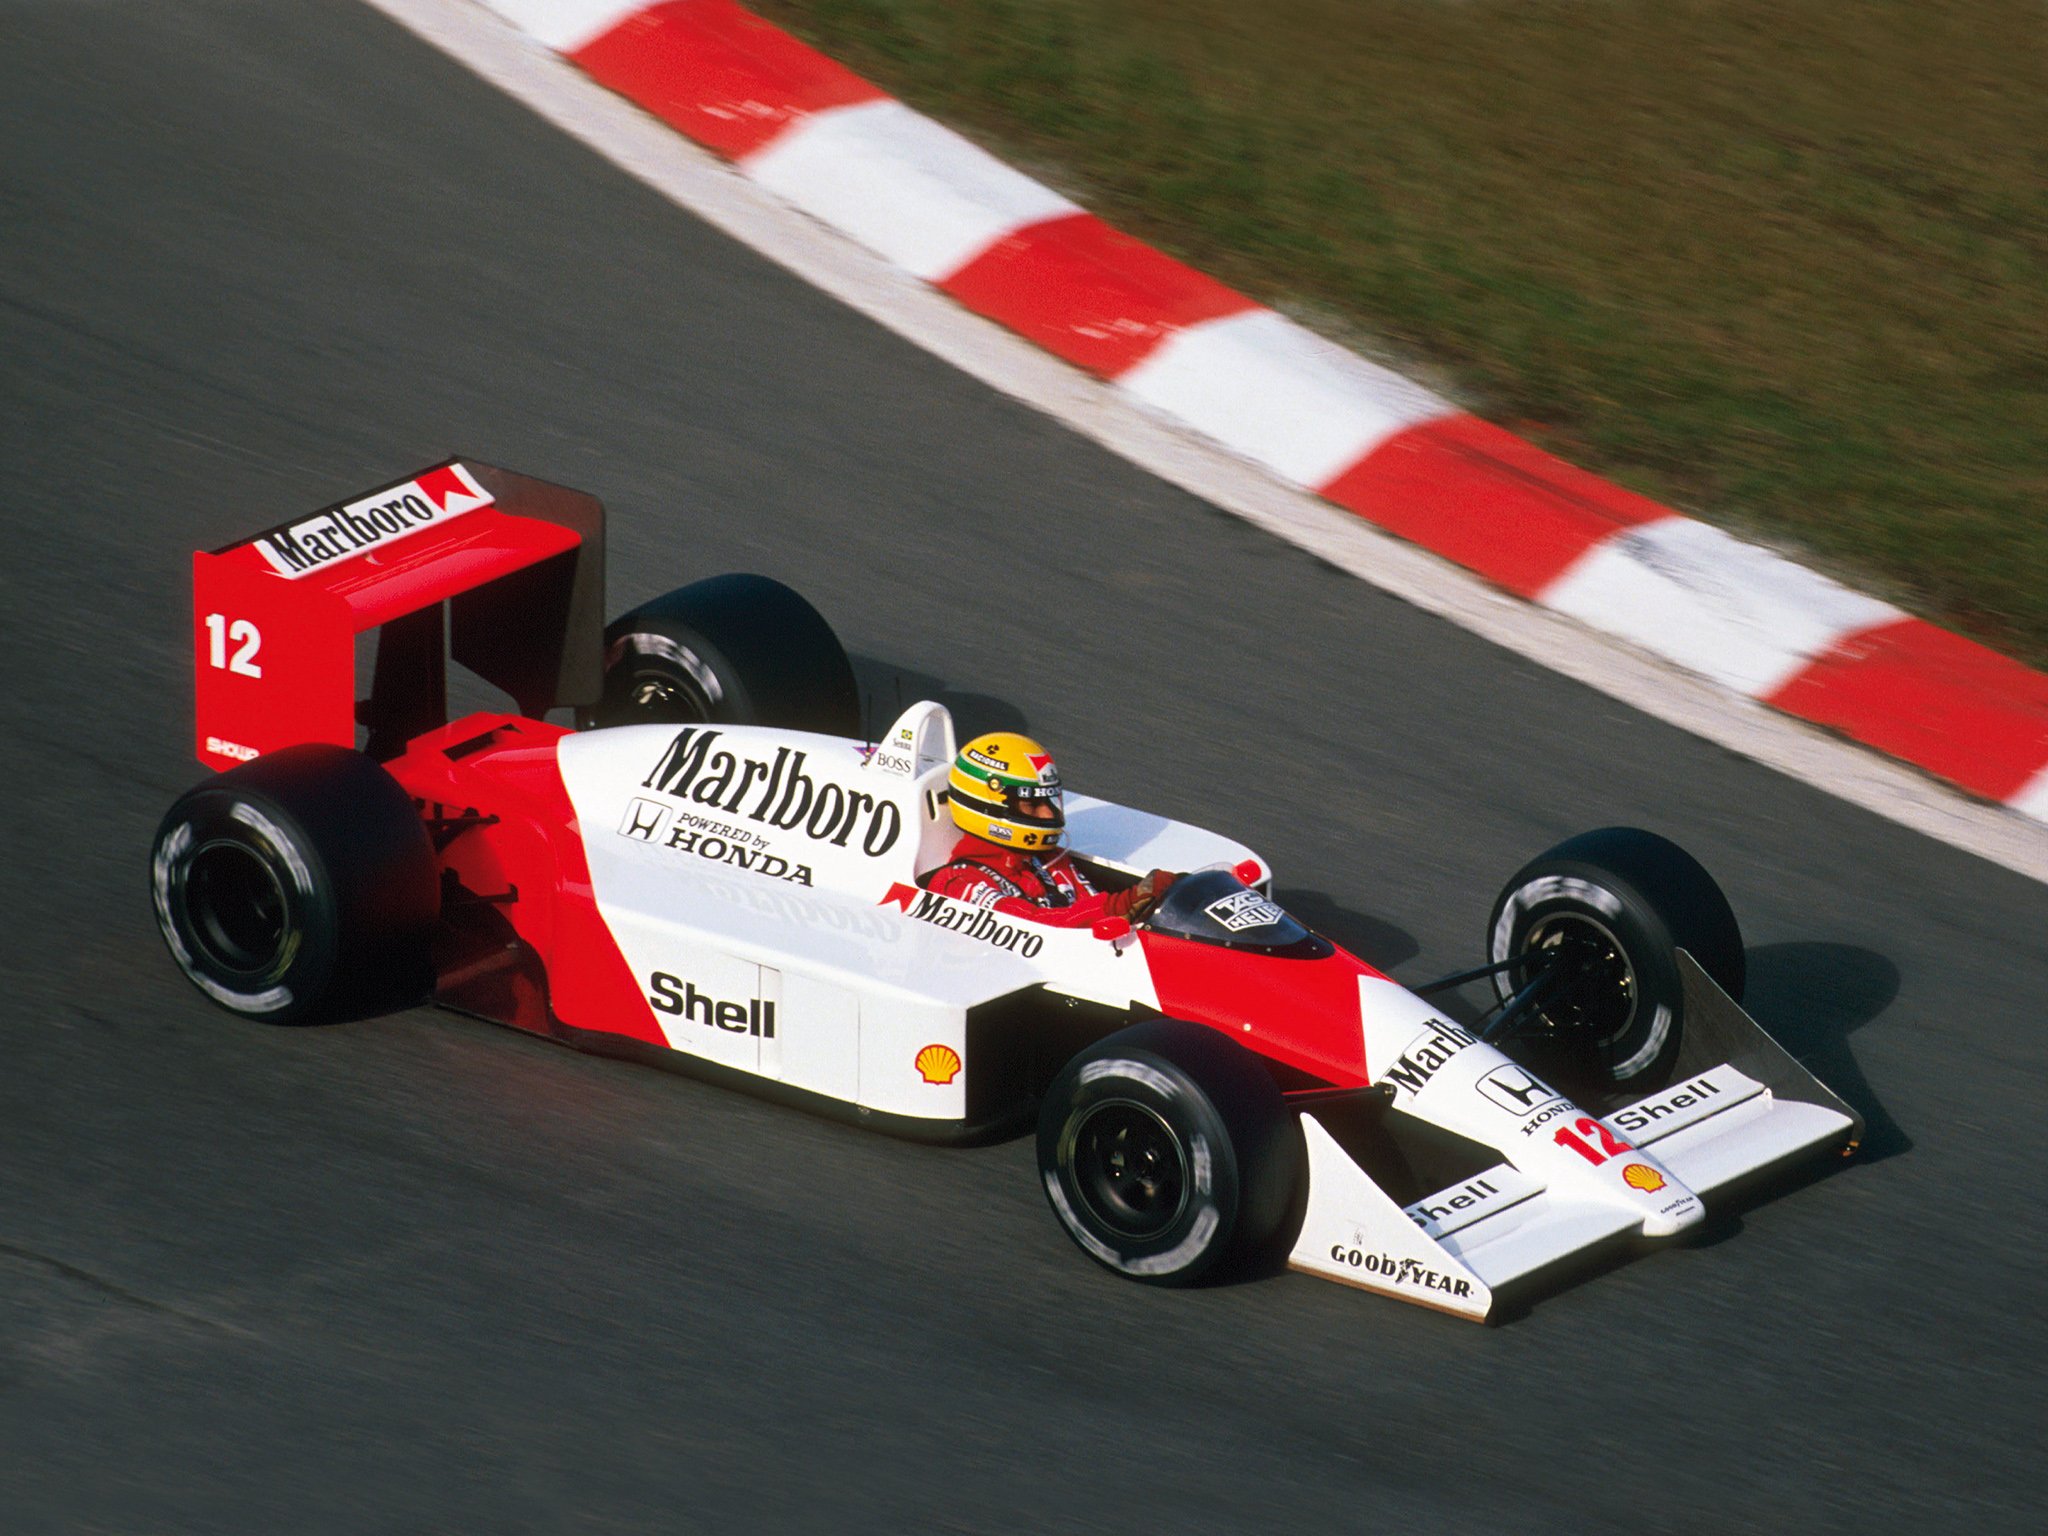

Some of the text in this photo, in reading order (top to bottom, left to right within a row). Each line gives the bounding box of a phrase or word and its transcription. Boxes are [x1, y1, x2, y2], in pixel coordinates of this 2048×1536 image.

[268, 494, 433, 572] Marlboro
[205, 613, 262, 679] 12
[641, 727, 901, 858] Marlboro
[877, 752, 912, 773] BOSS
[664, 827, 815, 887] HONDA
[677, 812, 771, 850] POWERED by
[907, 891, 1044, 959] Marlboro
[1215, 893, 1264, 914] TAG
[650, 971, 775, 1039] Shell
[1613, 1079, 1720, 1131] Shell
[1553, 1117, 1634, 1167] 12
